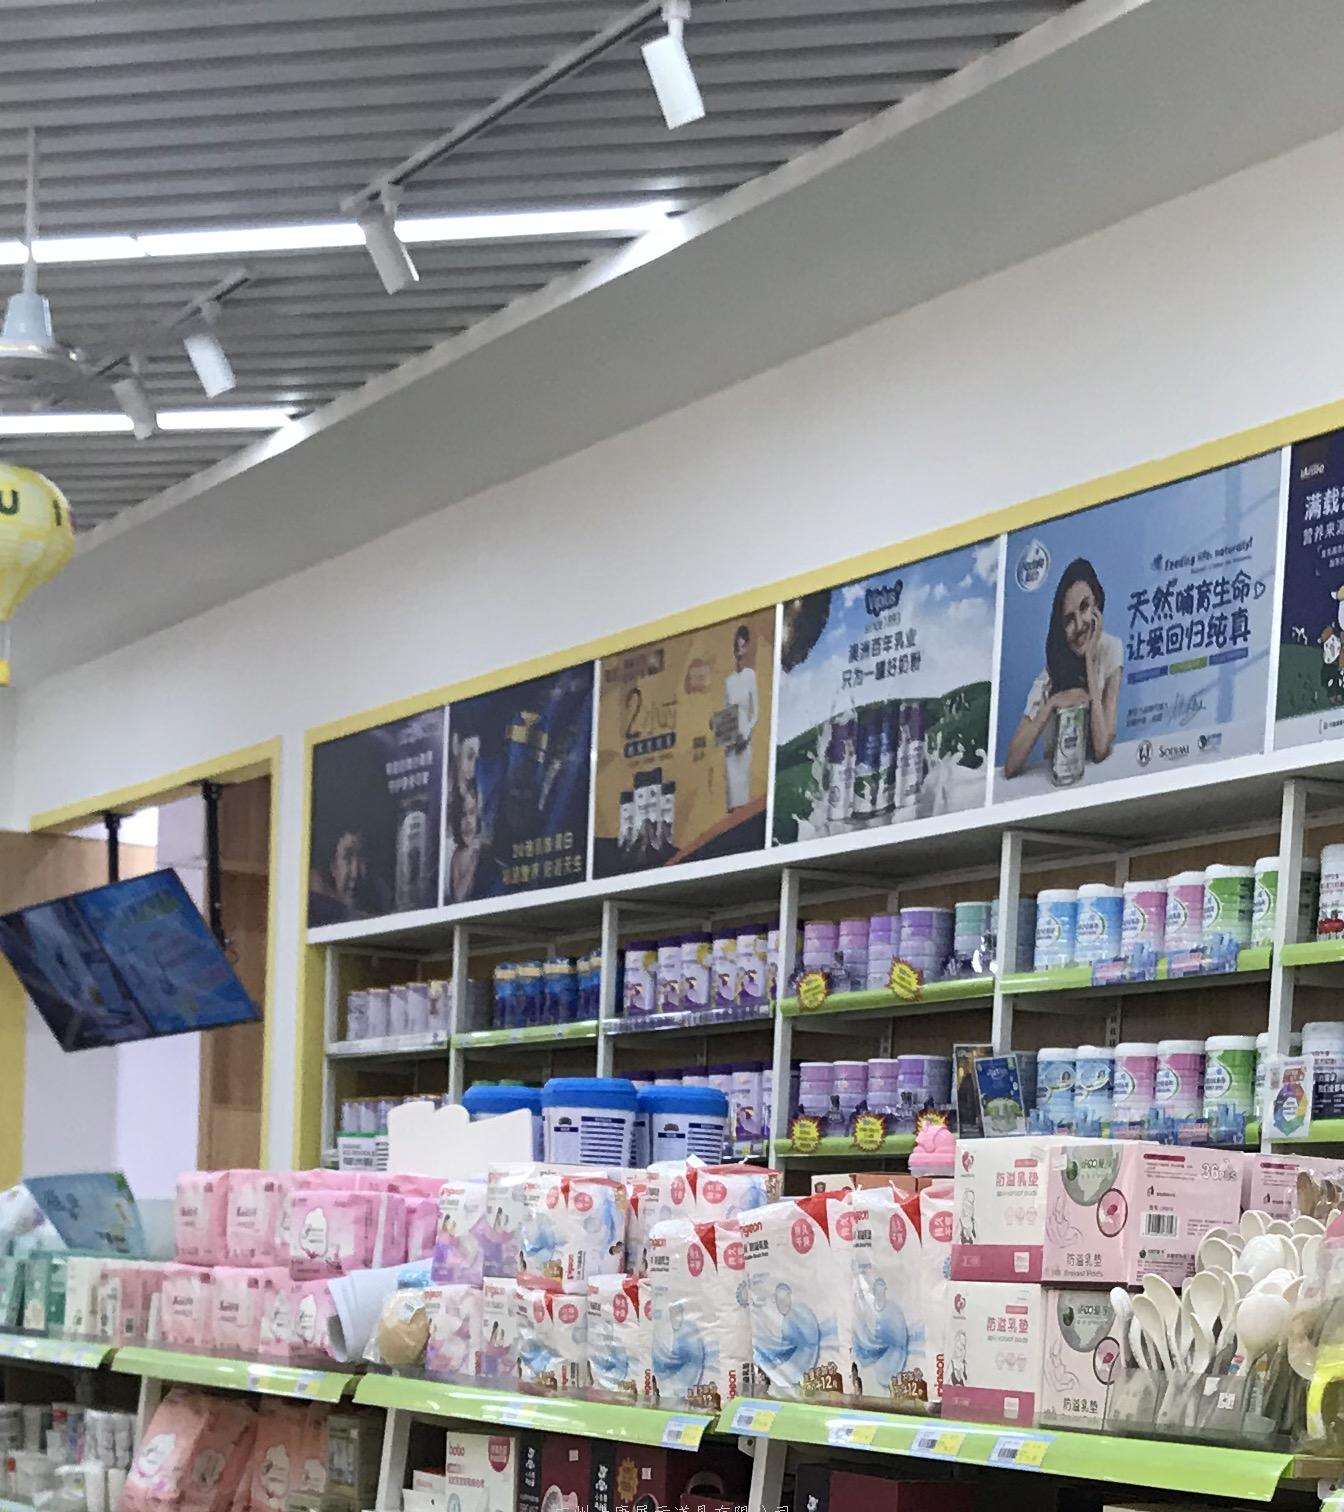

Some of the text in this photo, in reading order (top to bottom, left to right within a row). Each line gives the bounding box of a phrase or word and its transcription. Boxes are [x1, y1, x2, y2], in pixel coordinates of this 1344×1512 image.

[1127, 570, 1252, 629] 天然哺育生命
[1127, 607, 1252, 661] 让爱回归纯真
[996, 1171, 1040, 1188] 防溢乳垫
[1066, 1252, 1103, 1268] 防溢乳垫
[987, 1316, 1029, 1334] 防溢乳垫
[1063, 1397, 1099, 1413] 防溢乳垫
